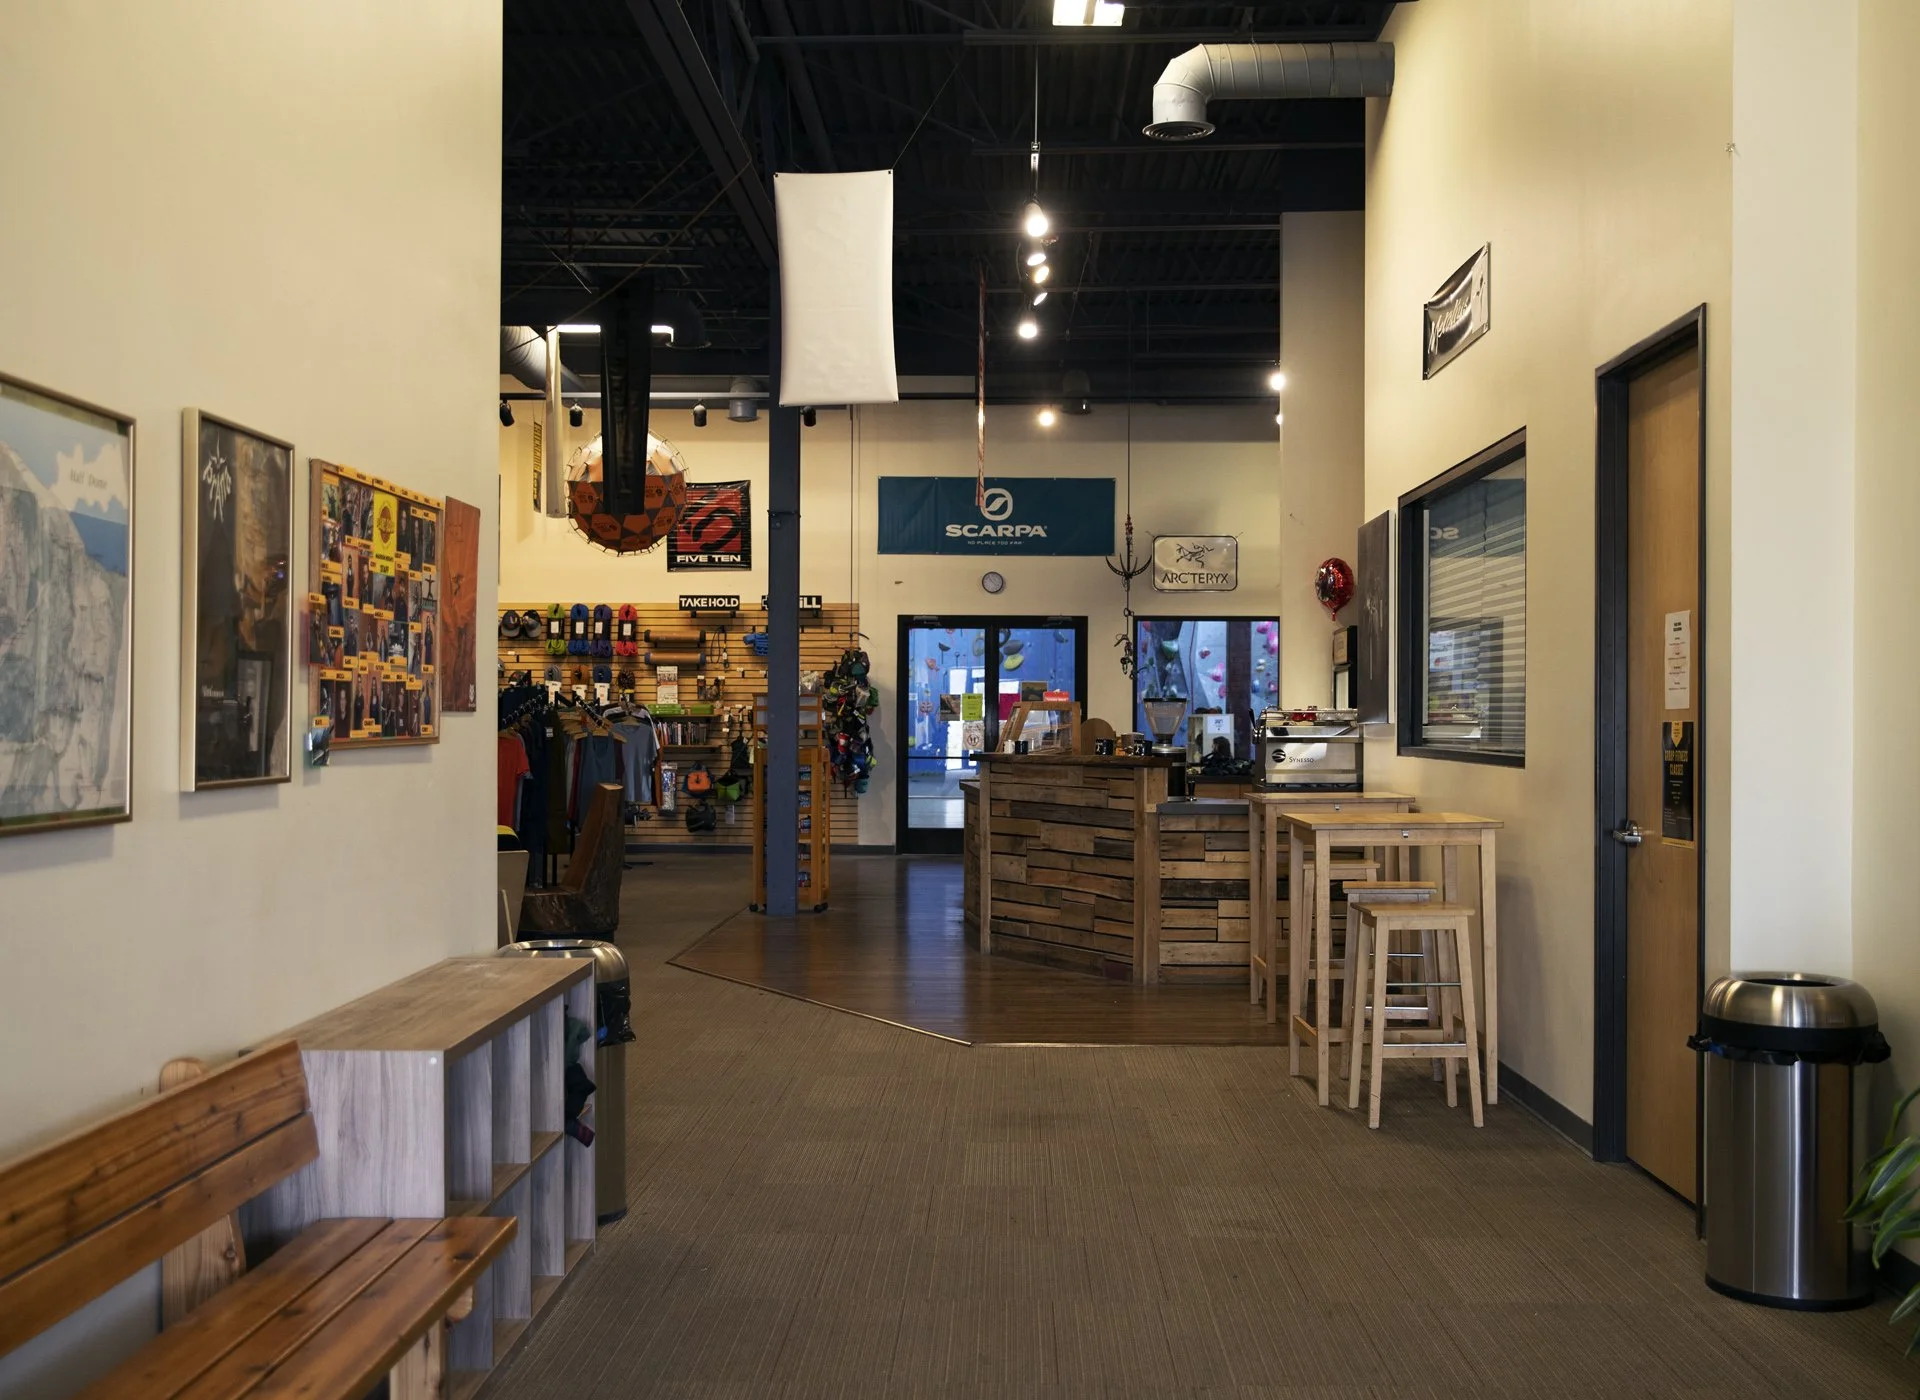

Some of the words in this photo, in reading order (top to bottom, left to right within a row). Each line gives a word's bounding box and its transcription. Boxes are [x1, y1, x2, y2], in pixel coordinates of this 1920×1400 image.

[945, 524, 1047, 538] SCARPA
[677, 555, 708, 563] FIVE
[712, 554, 741, 562] TEN
[1162, 571, 1229, 584] ARC'TERYX
